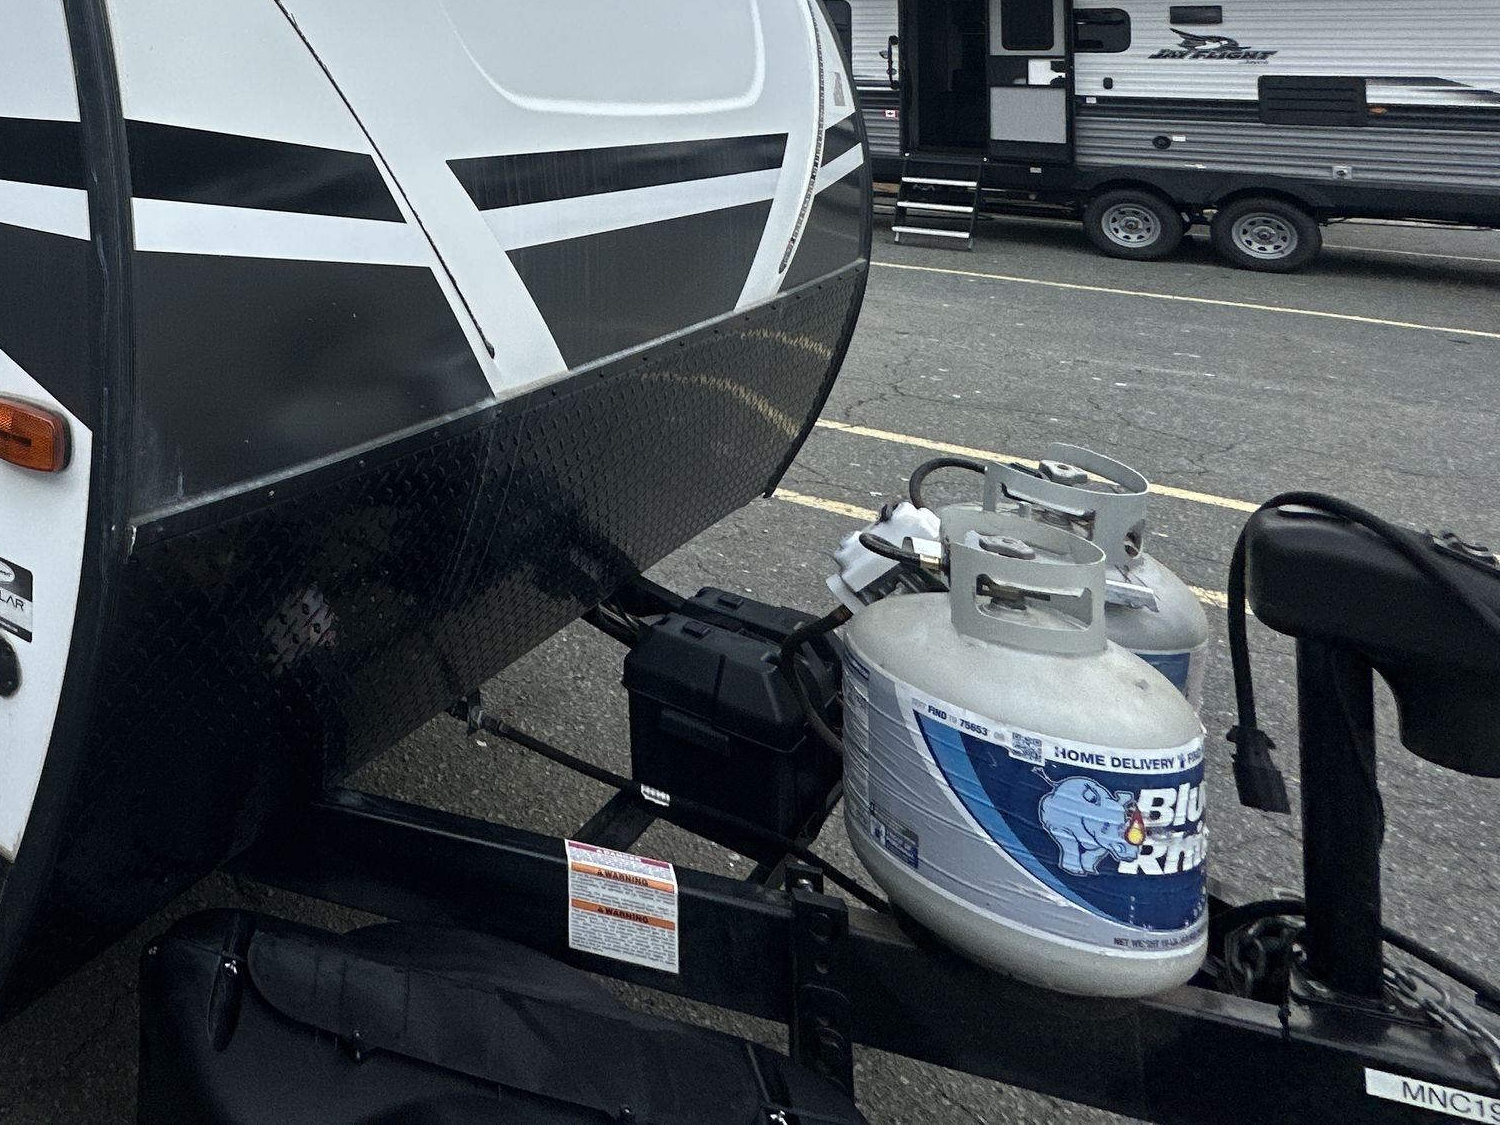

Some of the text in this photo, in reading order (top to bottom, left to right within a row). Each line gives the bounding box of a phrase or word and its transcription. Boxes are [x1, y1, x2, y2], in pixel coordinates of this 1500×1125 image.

[1148, 48, 1278, 60] JAY FLIGHT
[928, 704, 947, 720] FIND
[1054, 746, 1174, 770] HOME DELIVERY
[1137, 781, 1207, 827] Blu
[605, 871, 649, 887] WARNING
[605, 908, 649, 924] WARNING
[1113, 937, 1129, 946] NET
